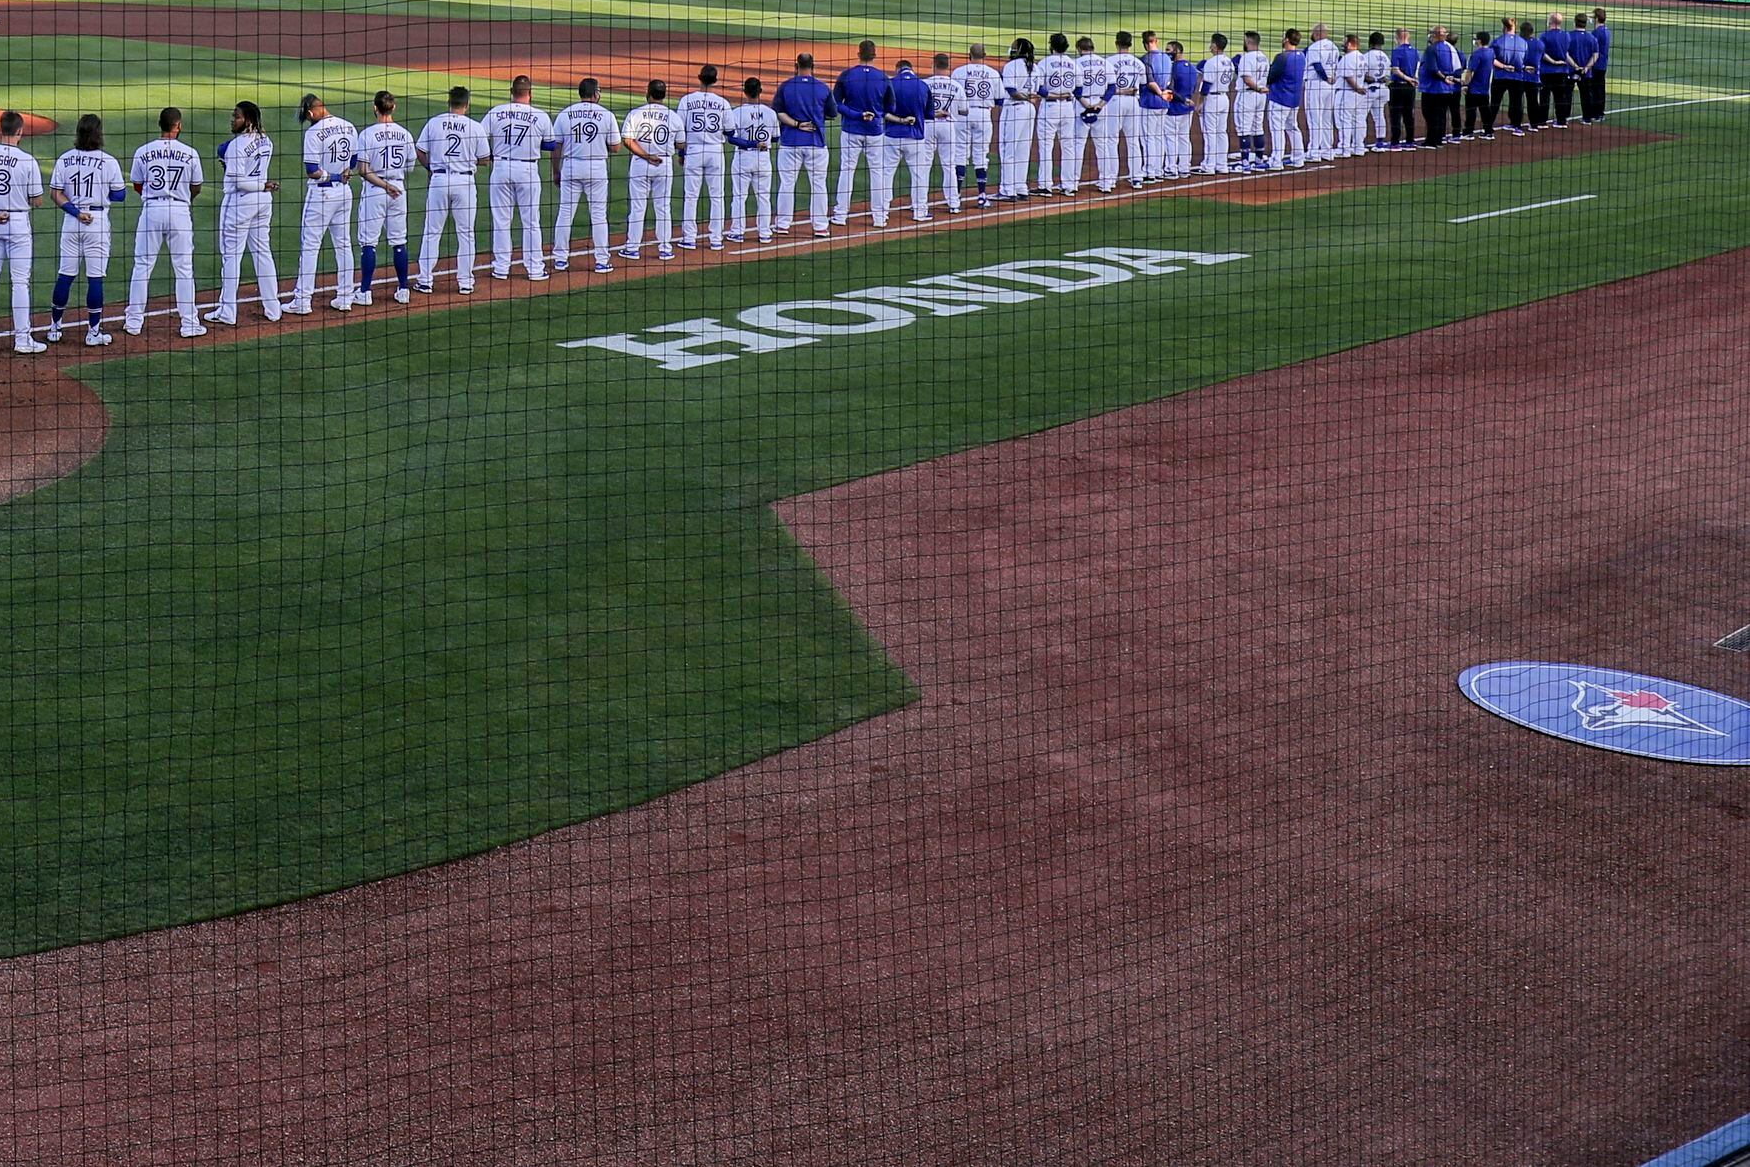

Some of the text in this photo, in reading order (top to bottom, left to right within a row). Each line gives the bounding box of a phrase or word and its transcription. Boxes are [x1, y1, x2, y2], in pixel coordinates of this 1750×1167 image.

[967, 71, 989, 79] MAYZA
[1049, 70, 1074, 88] 68
[1083, 70, 1106, 86] 56
[965, 79, 991, 99] 58
[496, 111, 538, 126] SCHNEIDER
[568, 110, 603, 122] HUDGENS
[642, 111, 669, 122] RIVERA
[691, 111, 720, 133] 53
[750, 112, 764, 121] KIM
[442, 121, 467, 132] PANIK
[501, 124, 530, 146] 17
[571, 121, 599, 144] 19
[638, 122, 670, 145] 20
[746, 123, 770, 143] 16
[328, 137, 351, 164] 13
[445, 133, 462, 157] 2
[63, 155, 106, 171] BICHETTE
[379, 145, 405, 169] 15
[69, 171, 94, 198] 11
[149, 165, 185, 191] 37
[556, 246, 1252, 371] HONDA
